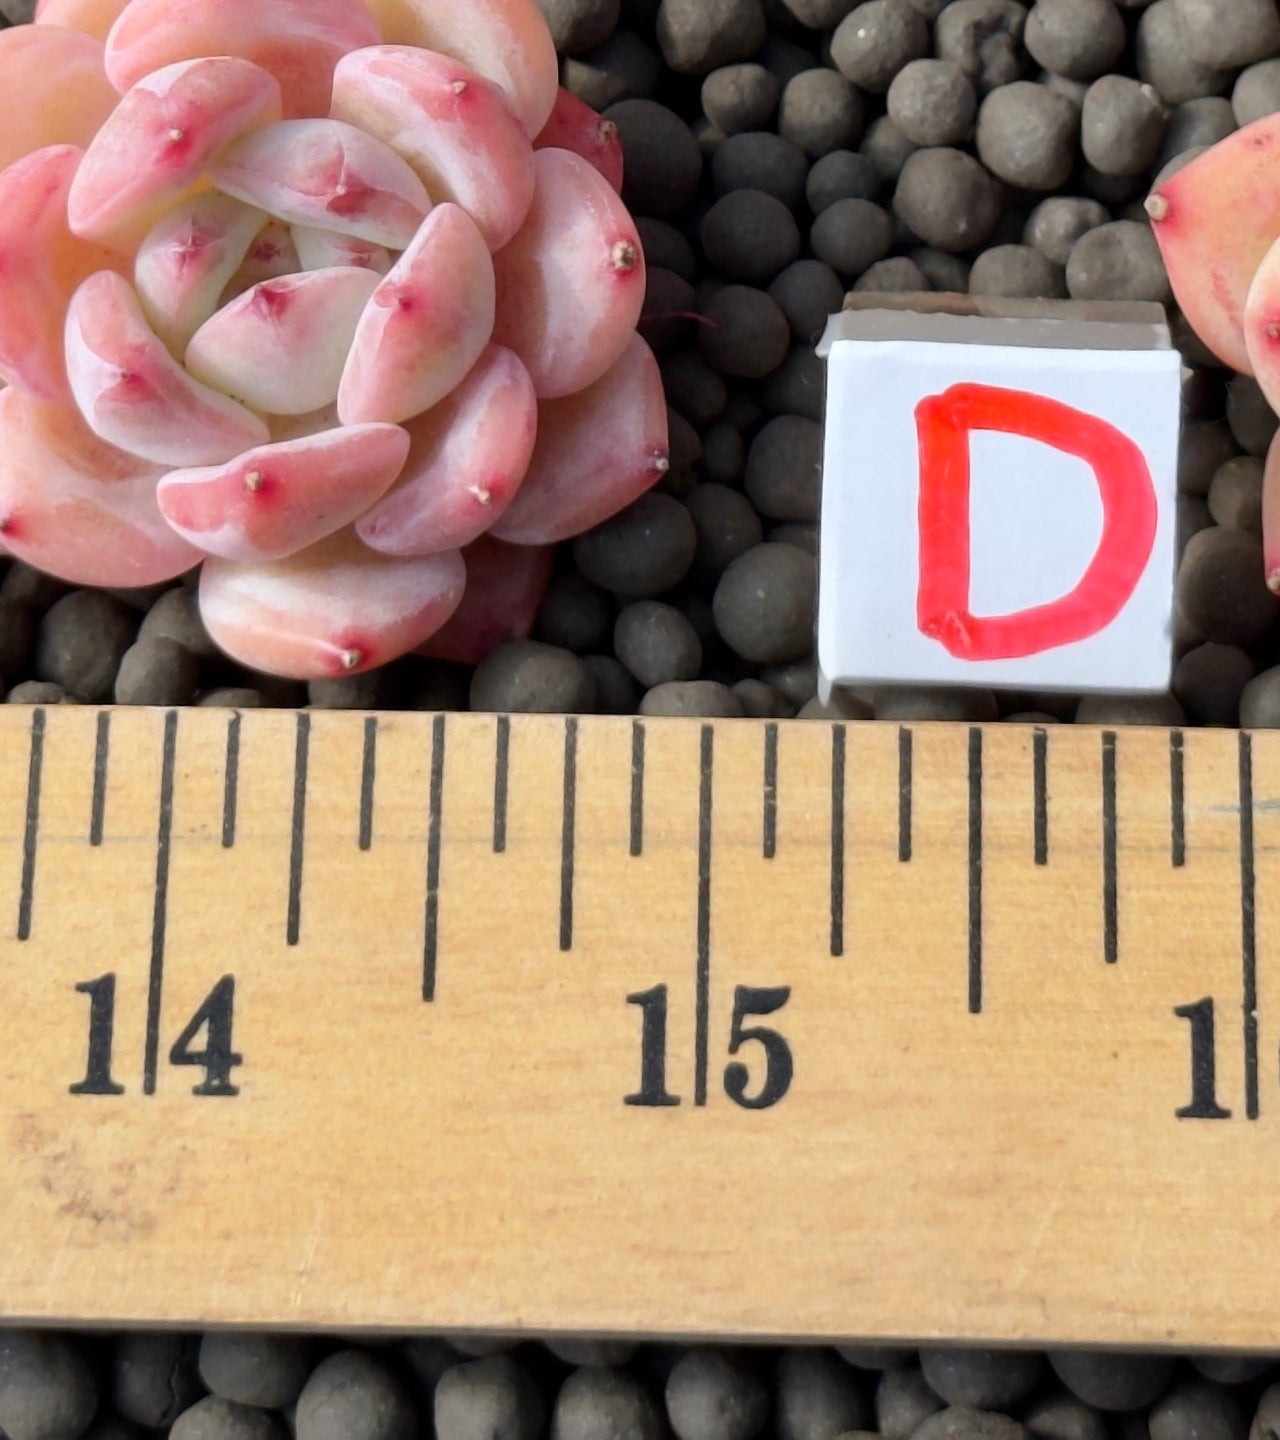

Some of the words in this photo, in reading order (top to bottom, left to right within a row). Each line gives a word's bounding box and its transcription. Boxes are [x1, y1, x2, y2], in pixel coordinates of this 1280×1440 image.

[914, 382, 1158, 661] D
[69, 972, 243, 1097] 14
[623, 983, 794, 1110] 15
